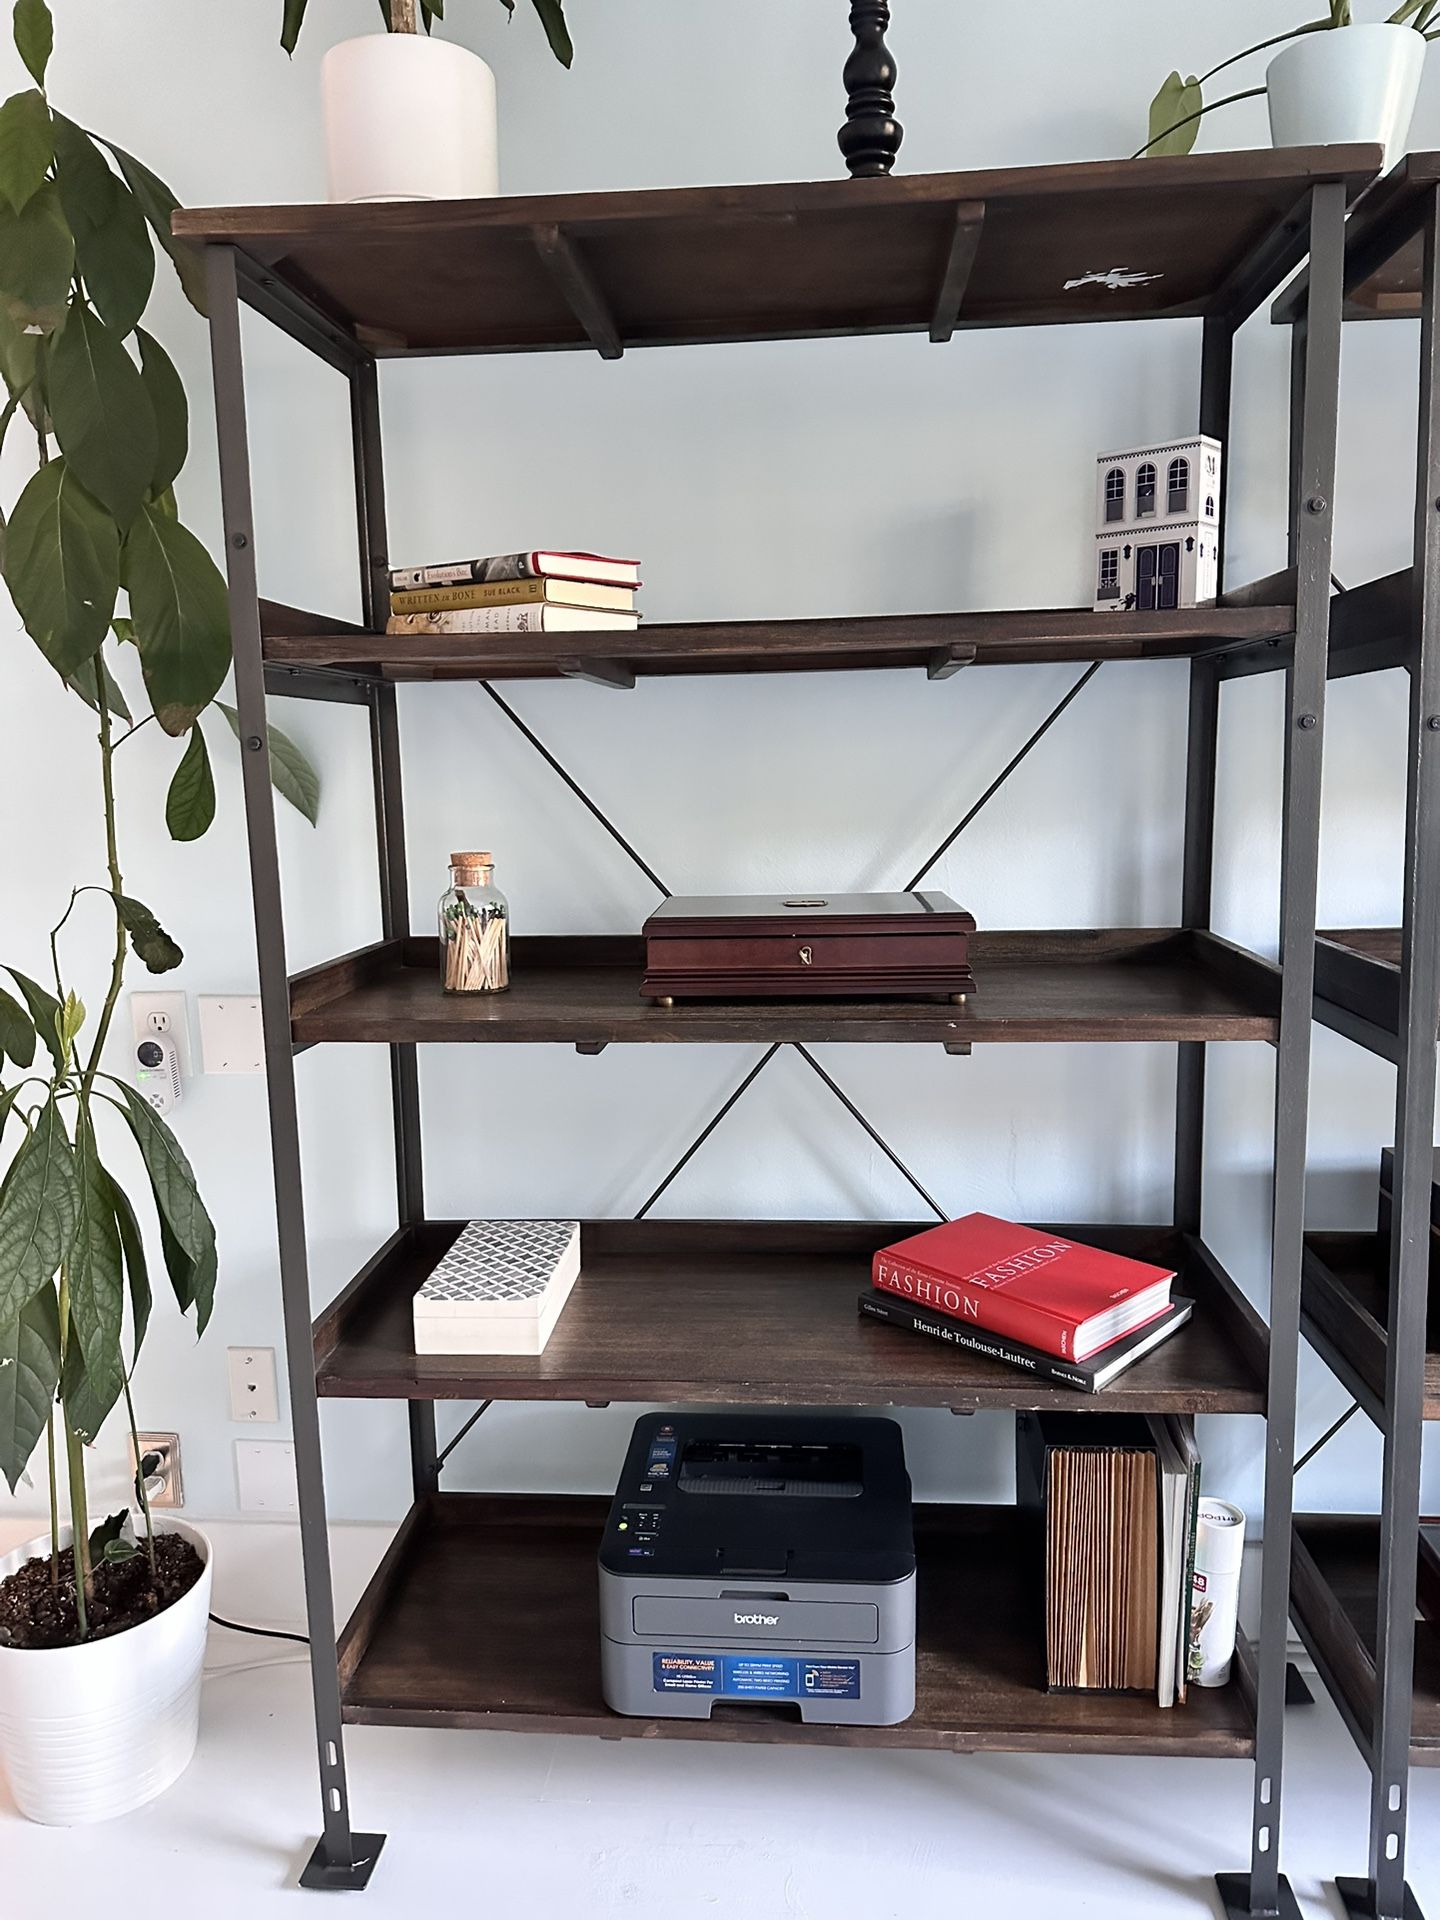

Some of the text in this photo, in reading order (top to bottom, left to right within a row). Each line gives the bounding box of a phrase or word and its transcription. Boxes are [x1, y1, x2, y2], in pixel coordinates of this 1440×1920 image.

[398, 593, 440, 606] WRITTEN
[452, 590, 475, 601] BONE
[483, 587, 520, 597] SUE BLACK
[968, 1240, 1073, 1289] FASHION
[878, 1264, 980, 1319] FASHION
[913, 1318, 1037, 1369] Henri de Toulouse-Lautrec
[734, 1613, 779, 1625] brother
